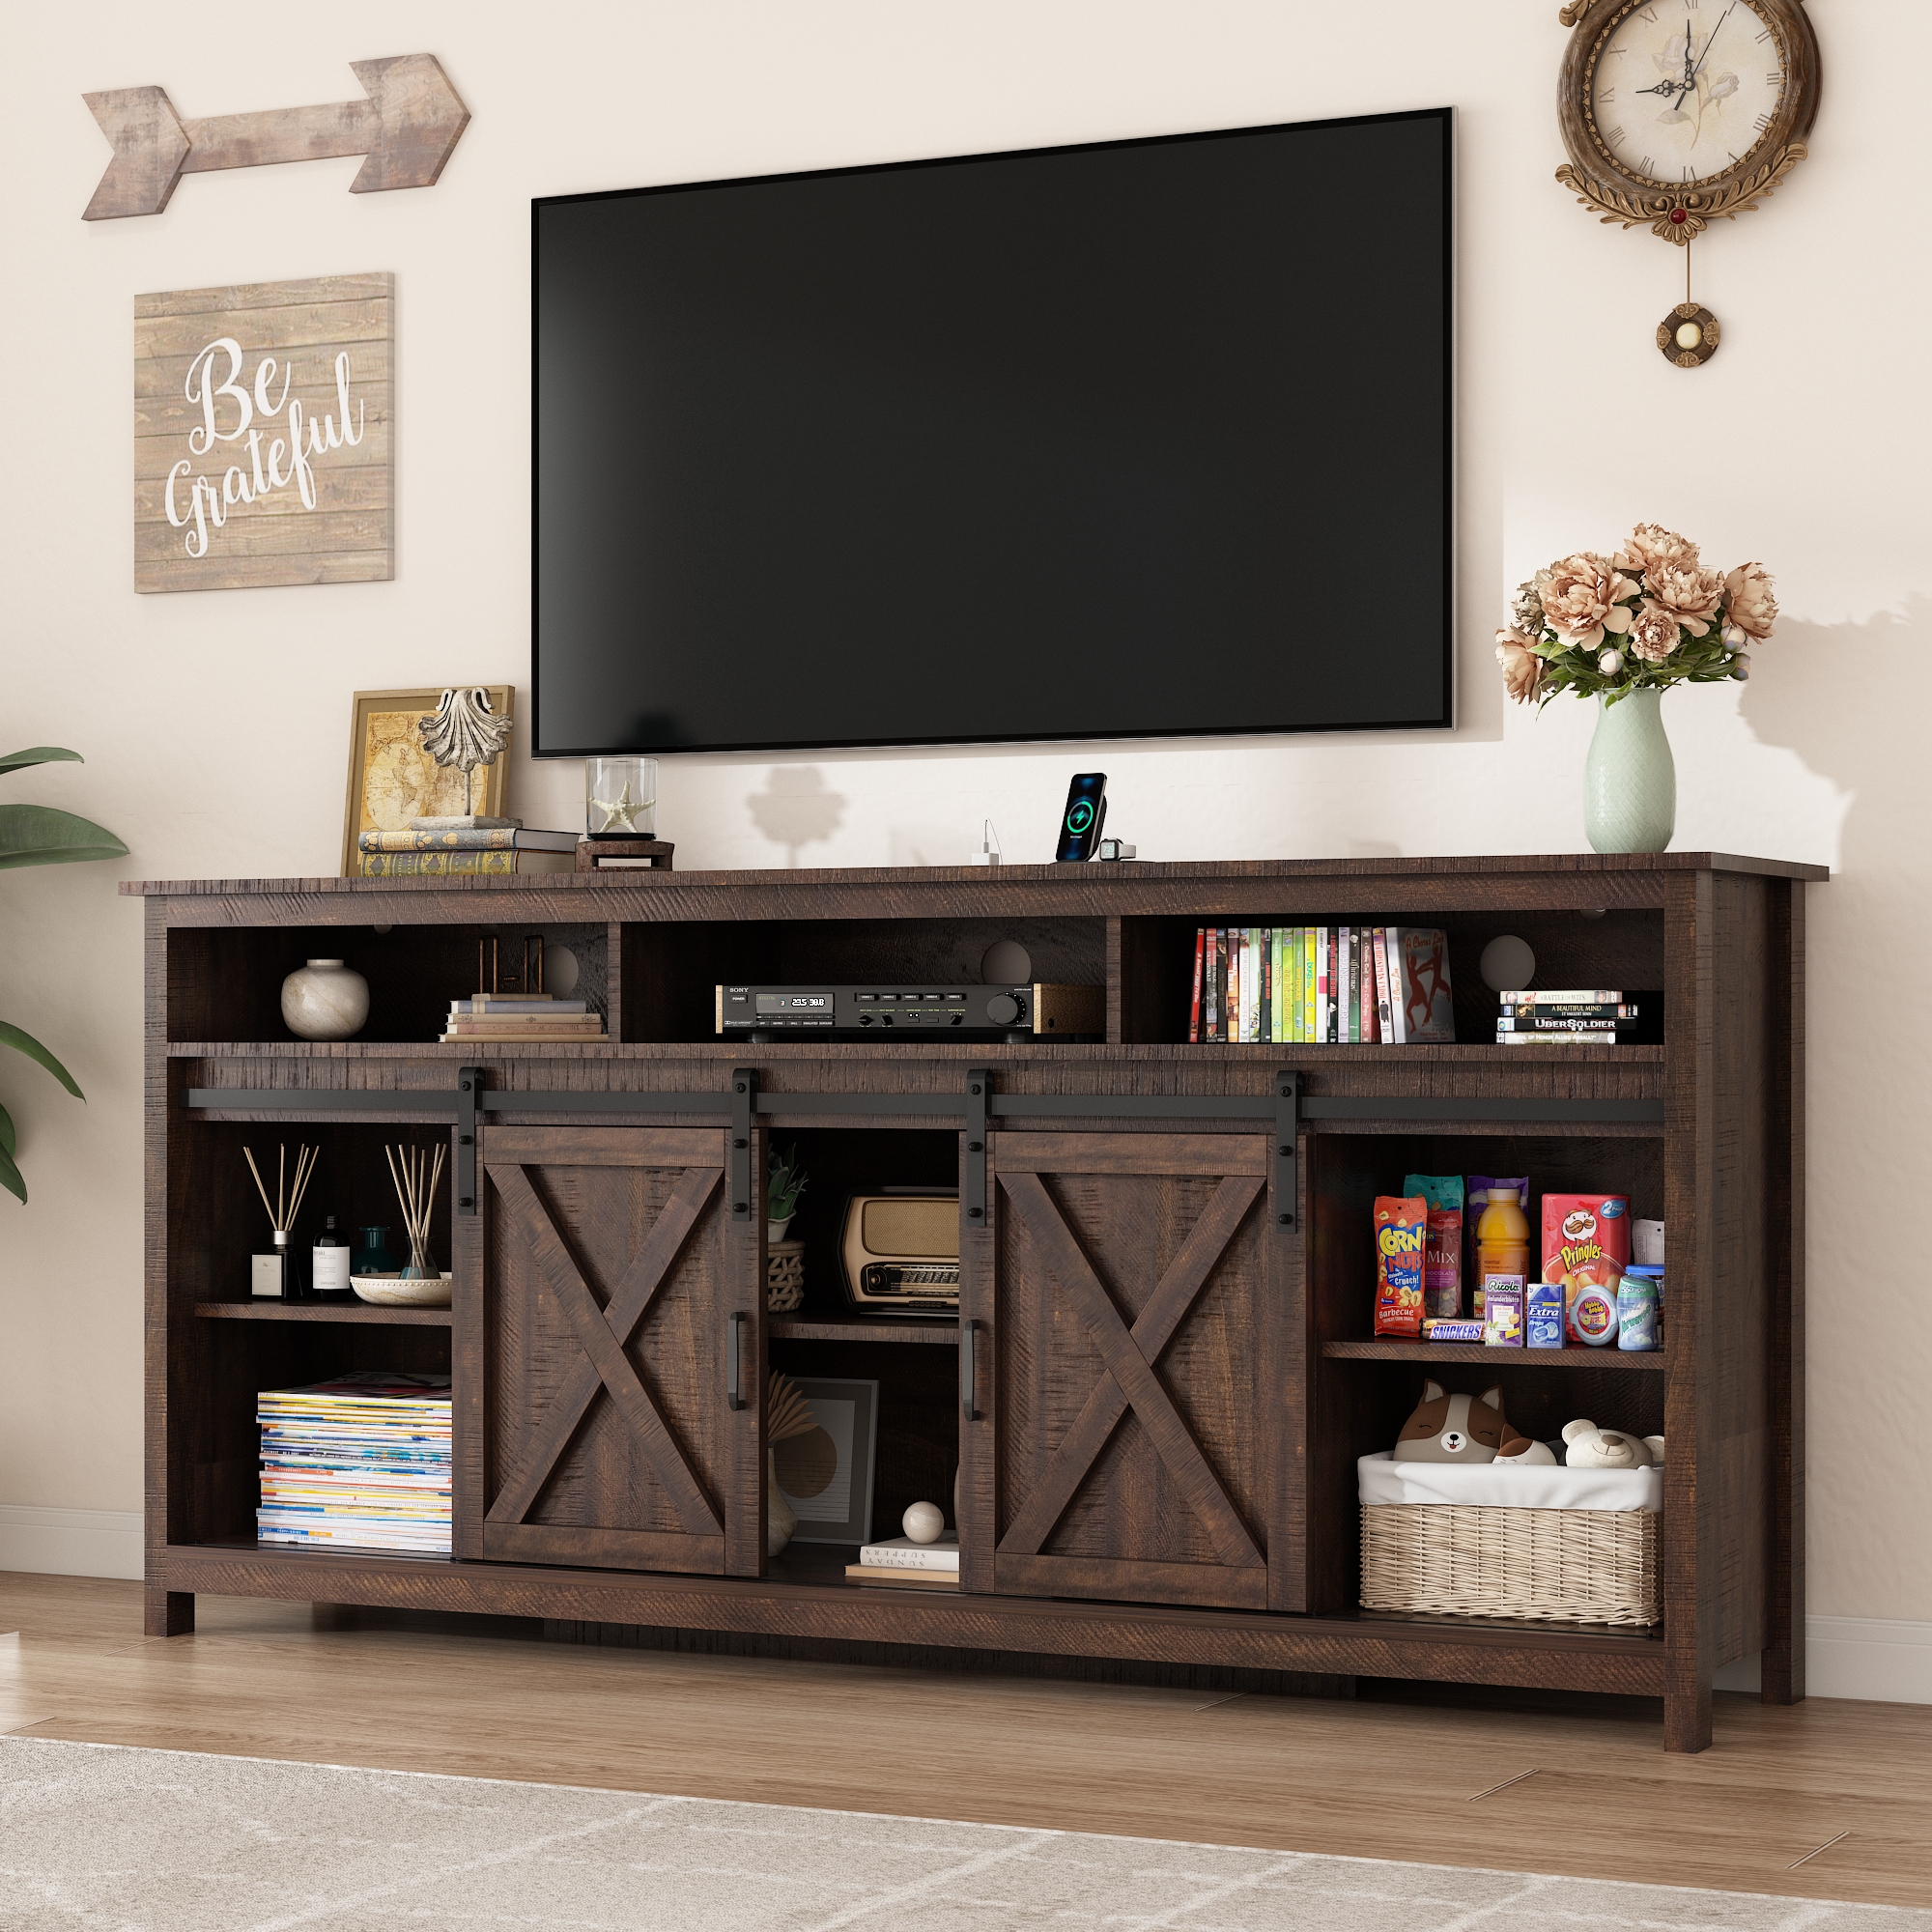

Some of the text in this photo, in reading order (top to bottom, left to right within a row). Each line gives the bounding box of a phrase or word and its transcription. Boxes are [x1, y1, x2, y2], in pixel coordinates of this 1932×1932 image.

[185, 337, 290, 455] Be
[165, 351, 364, 557] Grateful
[1413, 935, 1431, 948] Chorus
[1604, 1201, 1612, 1214] 2
[1379, 1226, 1423, 1256] CORN
[1388, 1251, 1423, 1273] NUTS
[1560, 1239, 1602, 1273] Pringles
[1572, 1265, 1596, 1277] ORIGINAL
[1395, 1275, 1419, 1285] Crunch!
[1488, 1280, 1520, 1292] Ricola
[1379, 1309, 1414, 1319] Barbecue
[1529, 1307, 1559, 1317] Extra
[1431, 1325, 1481, 1339] SNICKERS
[866, 1549, 926, 1558] SUPPERS
[868, 1558, 924, 1566] SUNDAY
